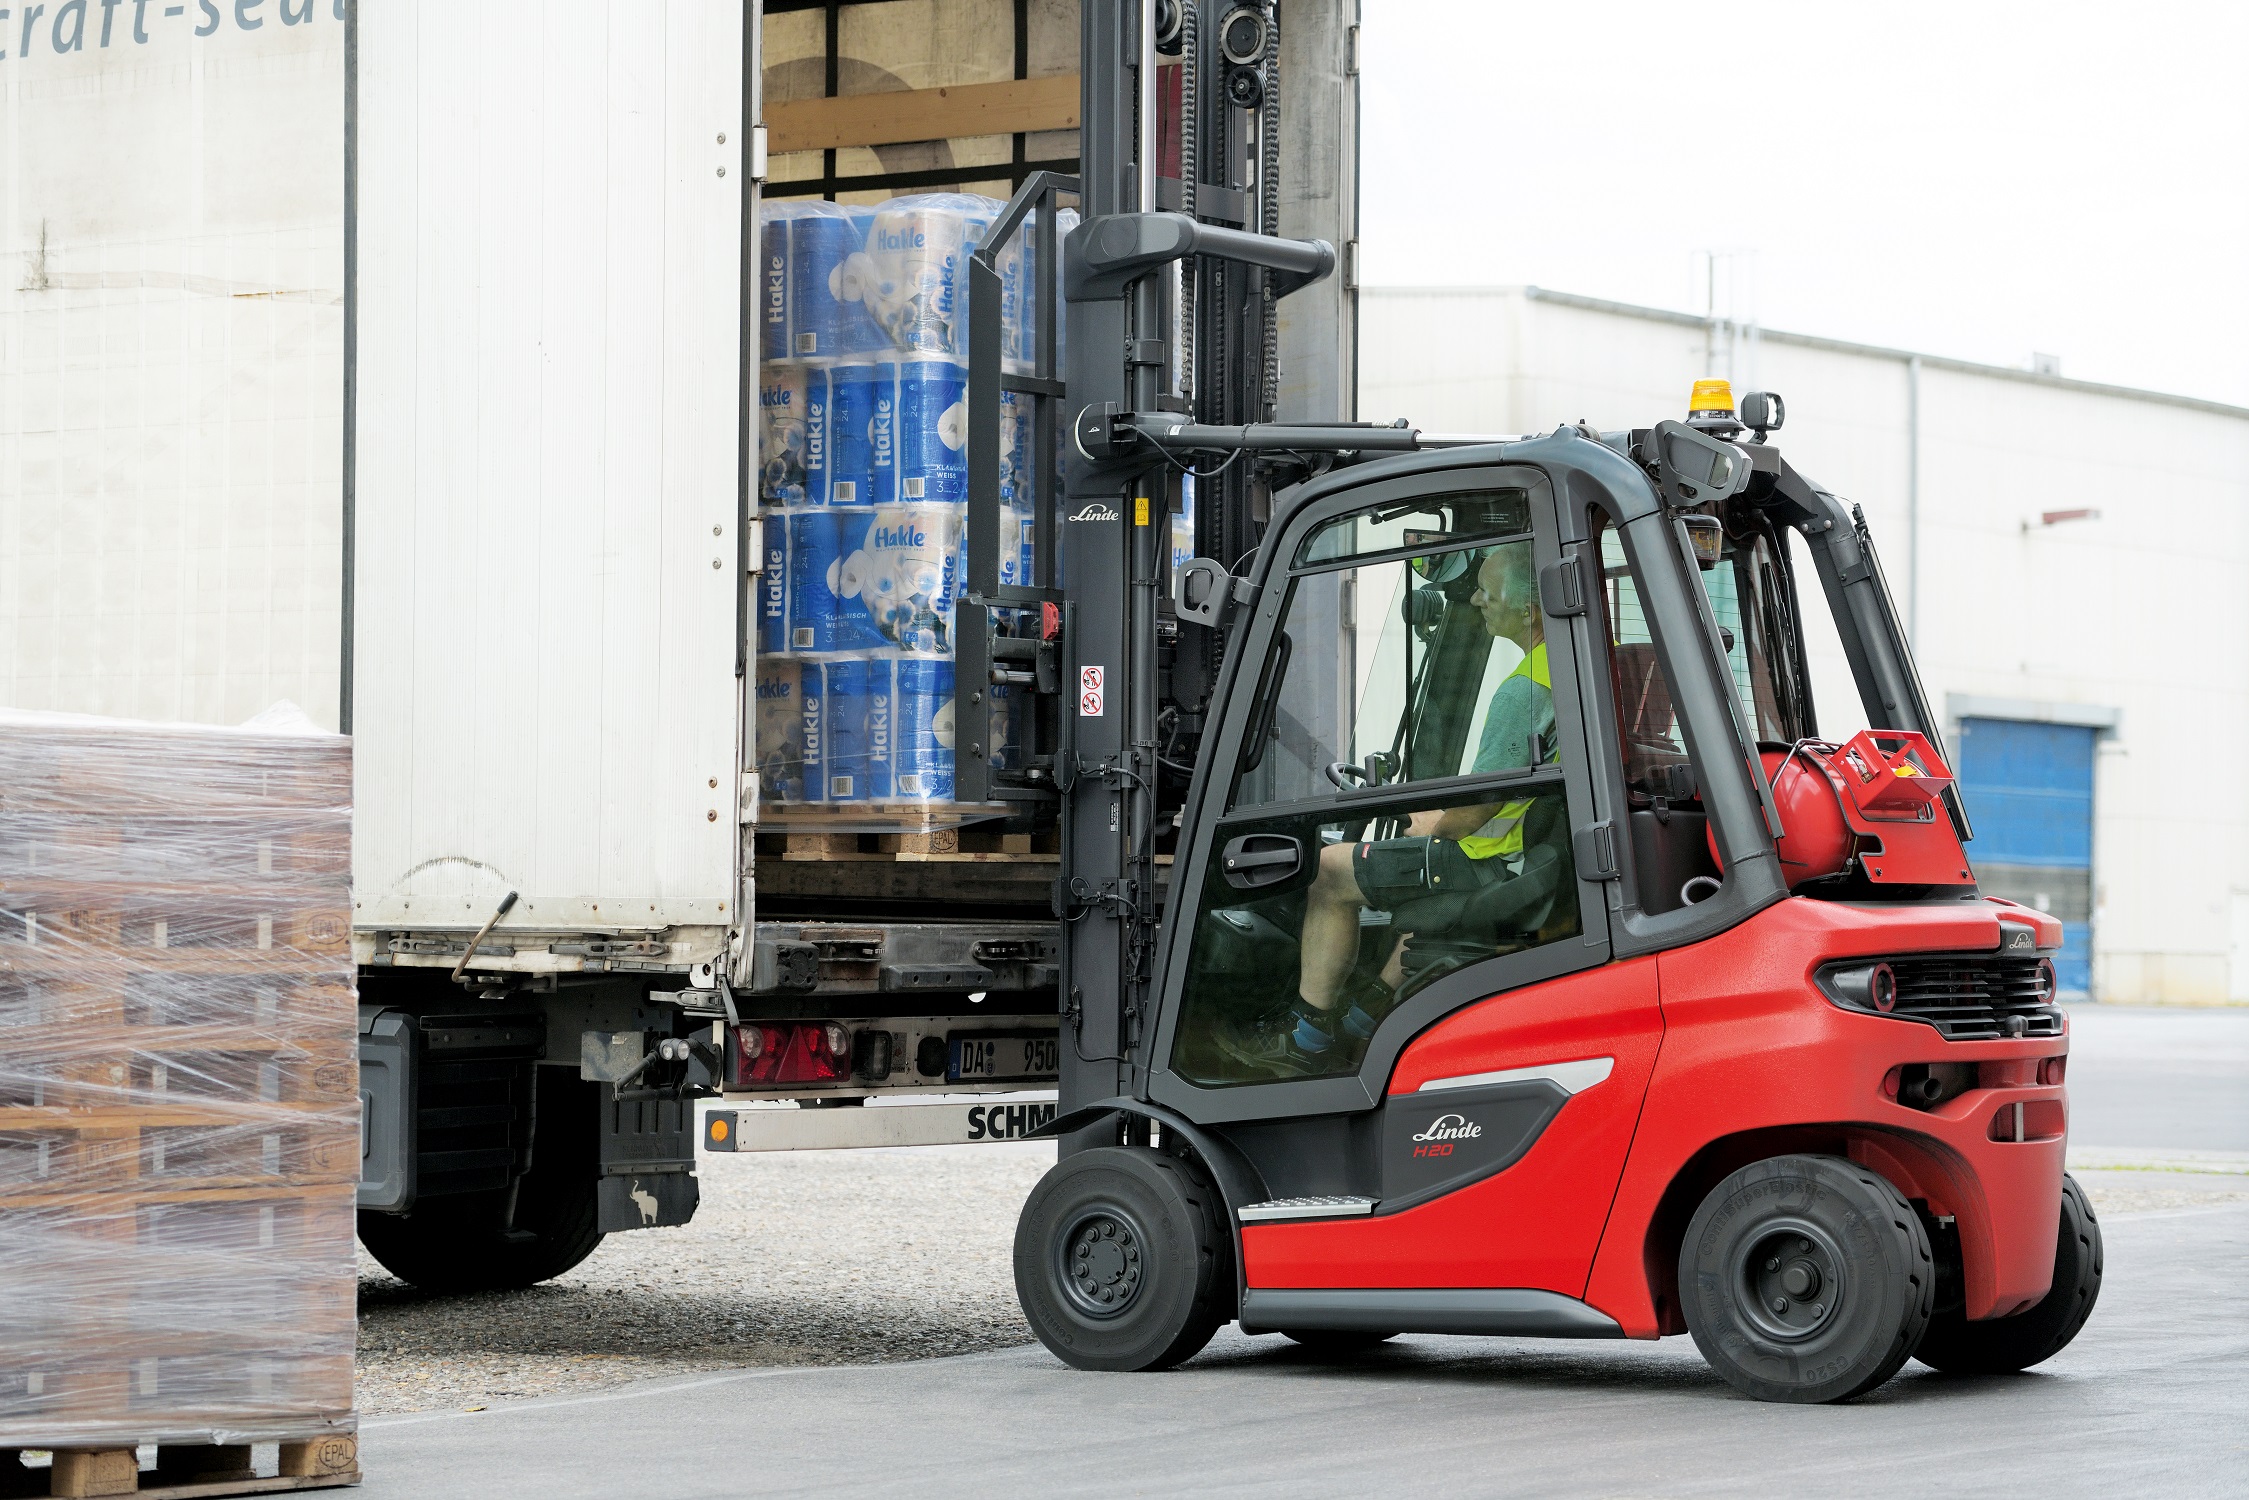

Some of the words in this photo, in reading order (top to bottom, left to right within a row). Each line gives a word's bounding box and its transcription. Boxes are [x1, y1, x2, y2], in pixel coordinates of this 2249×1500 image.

[878, 226, 925, 250] Hakle
[769, 256, 784, 323] Hakle
[938, 254, 954, 313] Hakle
[1003, 262, 1016, 319] Hakle
[808, 402, 823, 470] Hakle
[875, 399, 890, 466] Hakle
[875, 525, 926, 548] Hakle
[1069, 504, 1119, 522] Linde
[767, 549, 783, 617] Hakle
[937, 554, 954, 613] Hakle
[803, 698, 819, 765] Hakle
[870, 694, 888, 761] Hakle
[2008, 932, 2034, 949] Linde
[961, 1041, 984, 1073] DA
[1024, 1040, 1059, 1072] 950
[1413, 1114, 1482, 1142] Linde
[325, 1443, 351, 1462] EPAL
